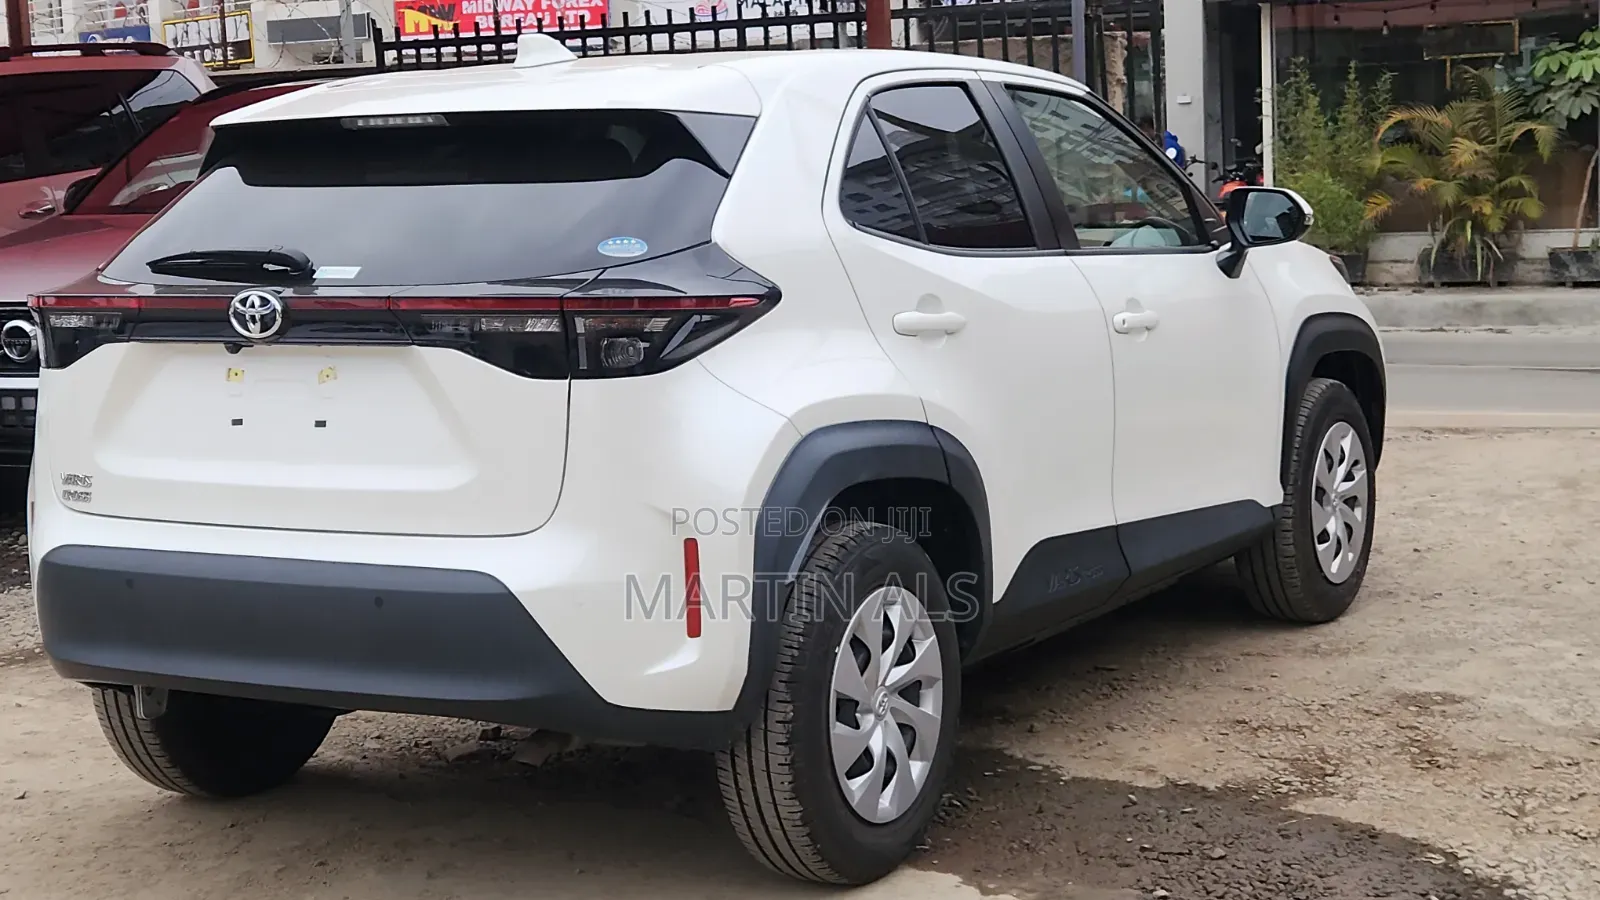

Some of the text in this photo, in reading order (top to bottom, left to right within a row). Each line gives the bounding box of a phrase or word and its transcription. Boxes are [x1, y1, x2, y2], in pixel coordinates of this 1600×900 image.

[462, 0, 535, 14] MIDWAY
[475, 9, 591, 29] BUREAU LTD
